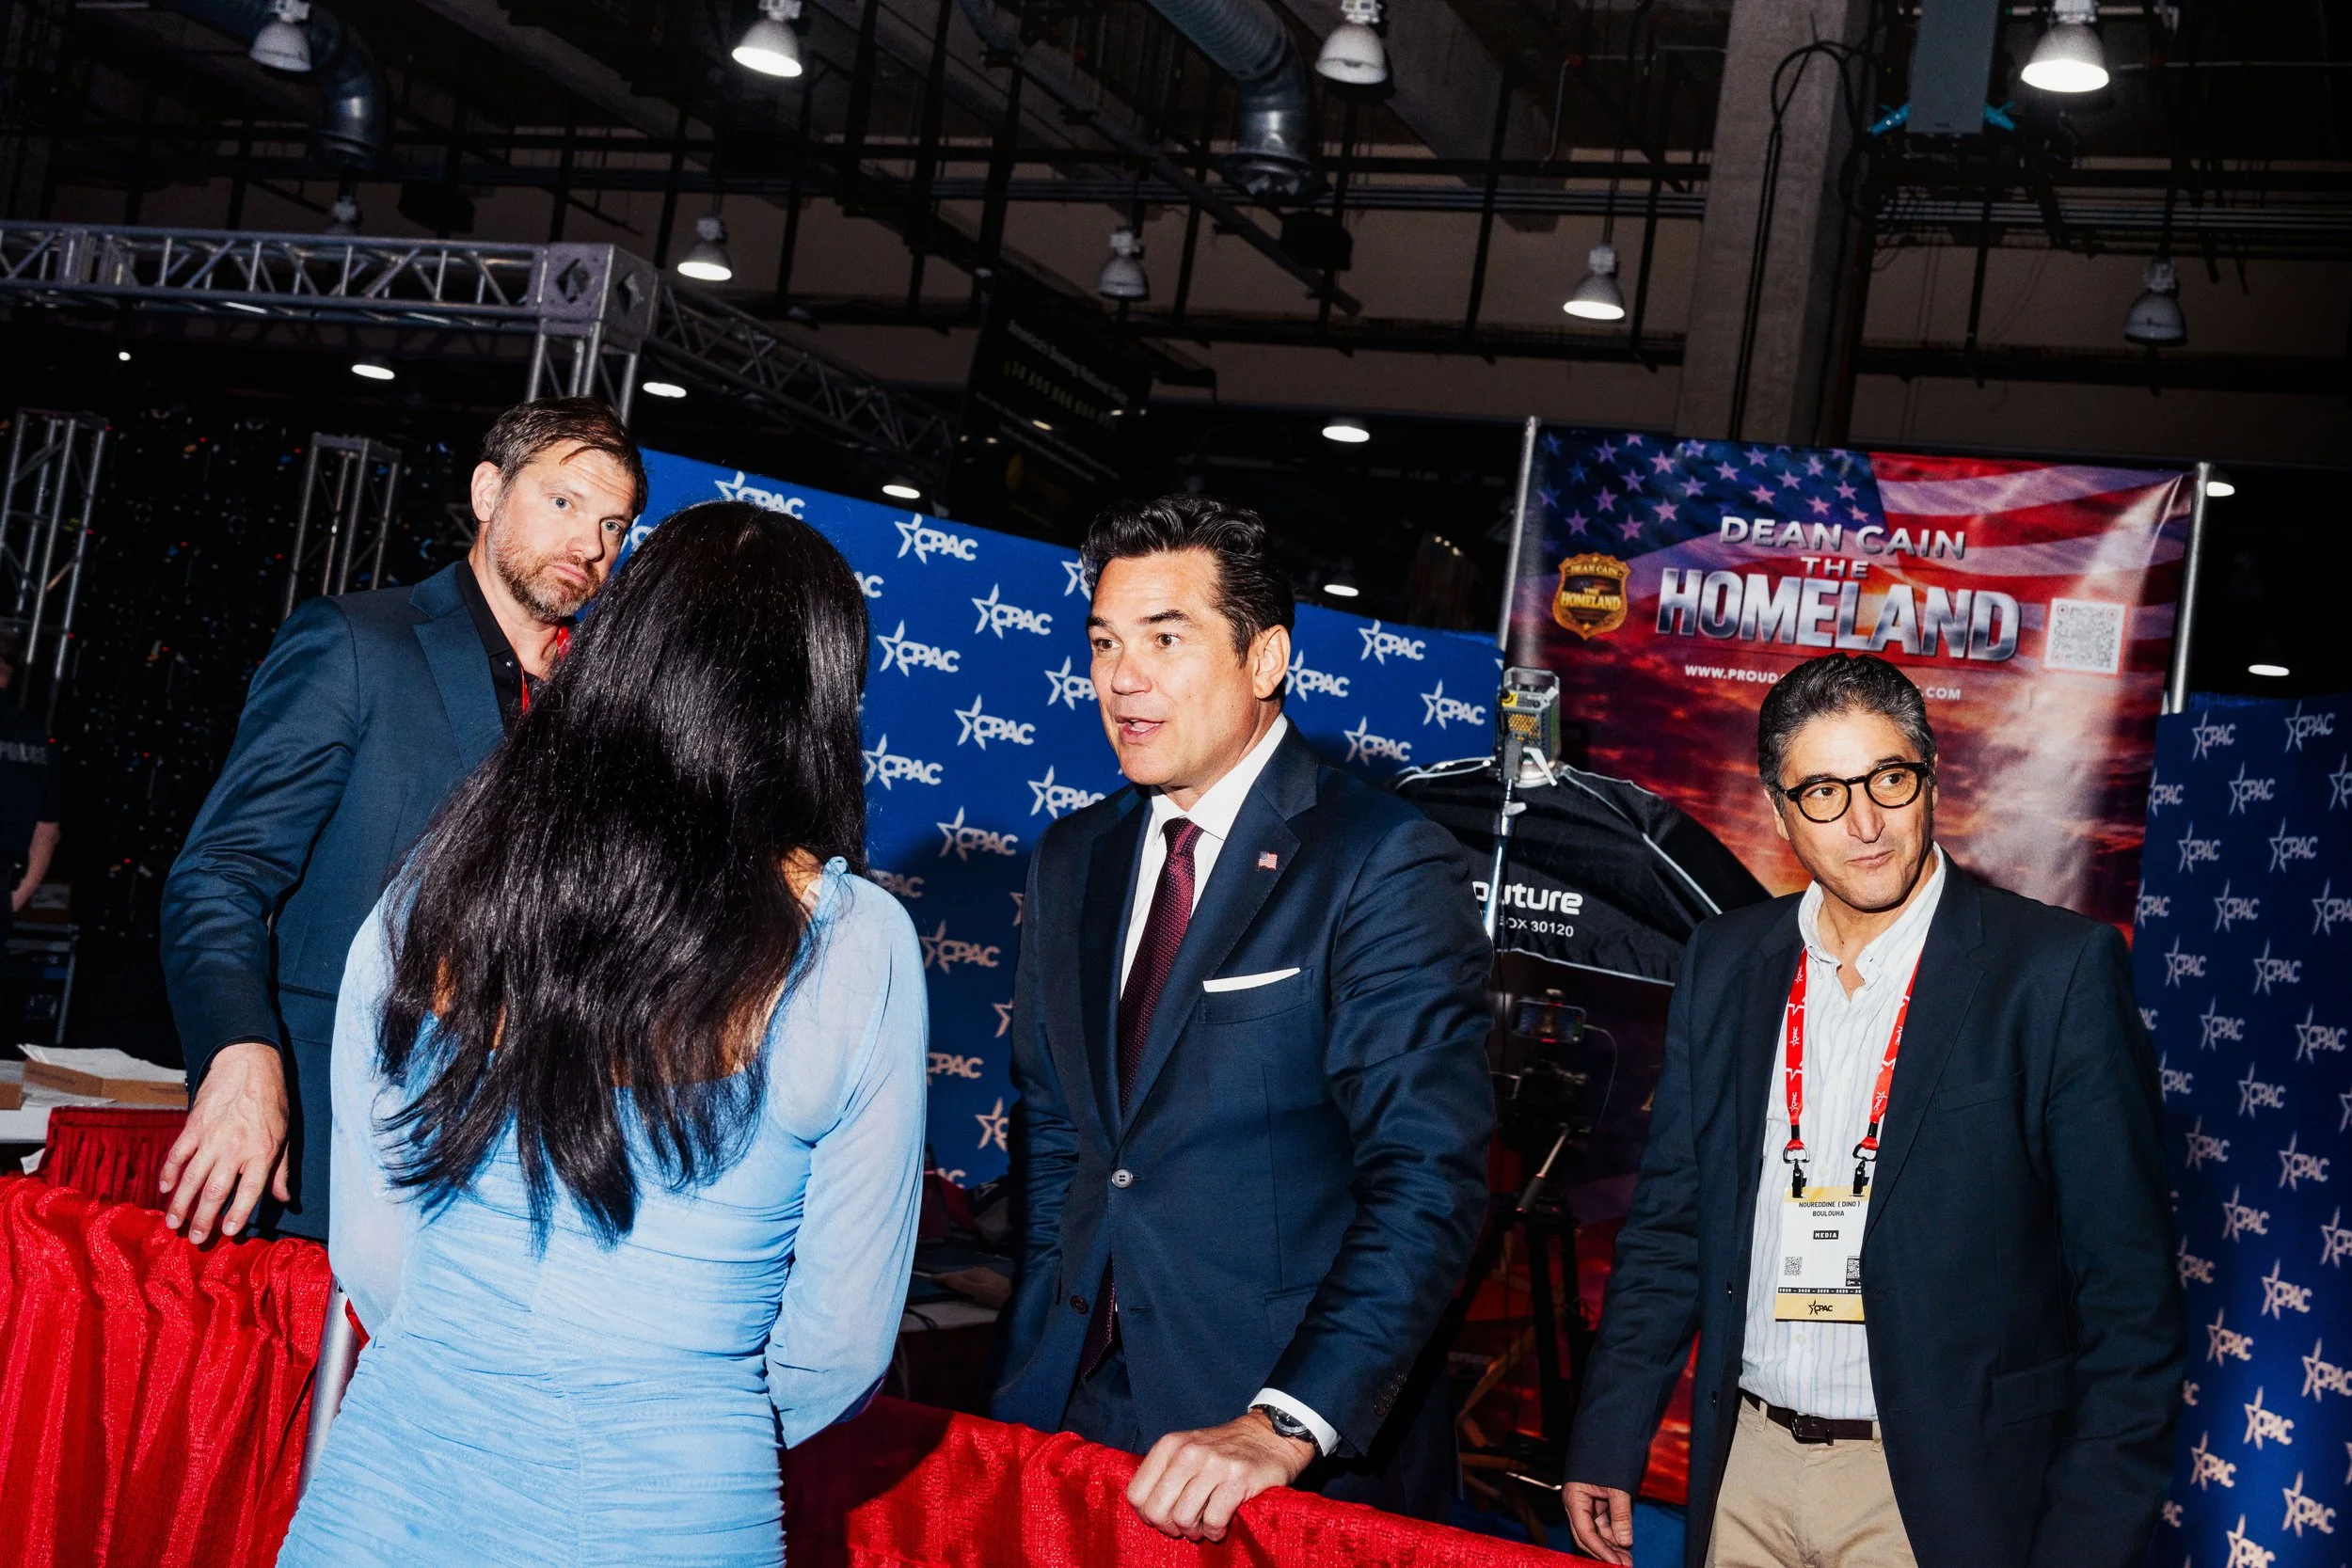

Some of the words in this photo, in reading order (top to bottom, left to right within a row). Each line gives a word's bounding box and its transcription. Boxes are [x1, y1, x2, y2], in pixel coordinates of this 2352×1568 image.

[914, 528, 978, 562] CPAC
[1720, 516, 1843, 551] DEAN
[1856, 525, 1966, 560] CAIN
[1801, 556, 1869, 578] THE
[1561, 592, 1622, 611] HOMELAND
[1656, 567, 2022, 661] HOMELAND
[991, 604, 1053, 635] CPAC
[896, 641, 961, 673] CPAC
[1374, 632, 1426, 660] CPAC
[1295, 669, 1350, 698] CPAC
[1436, 697, 1486, 725] CPAC
[2296, 712, 2336, 737] CPAC
[973, 715, 1036, 745] CPAC
[2201, 723, 2236, 746] CPAC
[1359, 735, 1412, 762] CPAC
[878, 754, 944, 785] CPAC
[2152, 784, 2185, 805] CPAC
[2239, 778, 2276, 801] CPAC
[956, 827, 1019, 856] CPAC
[2186, 838, 2221, 861] CPAC
[2279, 835, 2318, 859] CPAC
[2140, 895, 2170, 918] CPAC
[2224, 896, 2260, 921] CPAC
[2324, 897, 2352, 922] CPA
[1531, 921, 1575, 938] 30120
[937, 940, 1001, 968] CPAC
[2174, 953, 2207, 977] CPAC
[2265, 958, 2303, 984] CPAC
[2210, 1015, 2246, 1041] CPAC
[2306, 1025, 2348, 1053] CPAC
[2161, 1068, 2194, 1095] CPAC
[2248, 1081, 2286, 1109] CPAC
[2196, 1134, 2231, 1163] CPAC
[2290, 1152, 2330, 1182] CPAC
[2233, 1205, 2270, 1236] CPAC
[2181, 1254, 2216, 1284] CPAC
[2273, 1280, 2313, 1313] CPAC
[2217, 1327, 2254, 1361] CPAC
[2254, 1408, 2295, 1446] CPAC
[2200, 1451, 2237, 1488] CPAC
[2294, 1495, 2337, 1534] CPAC
